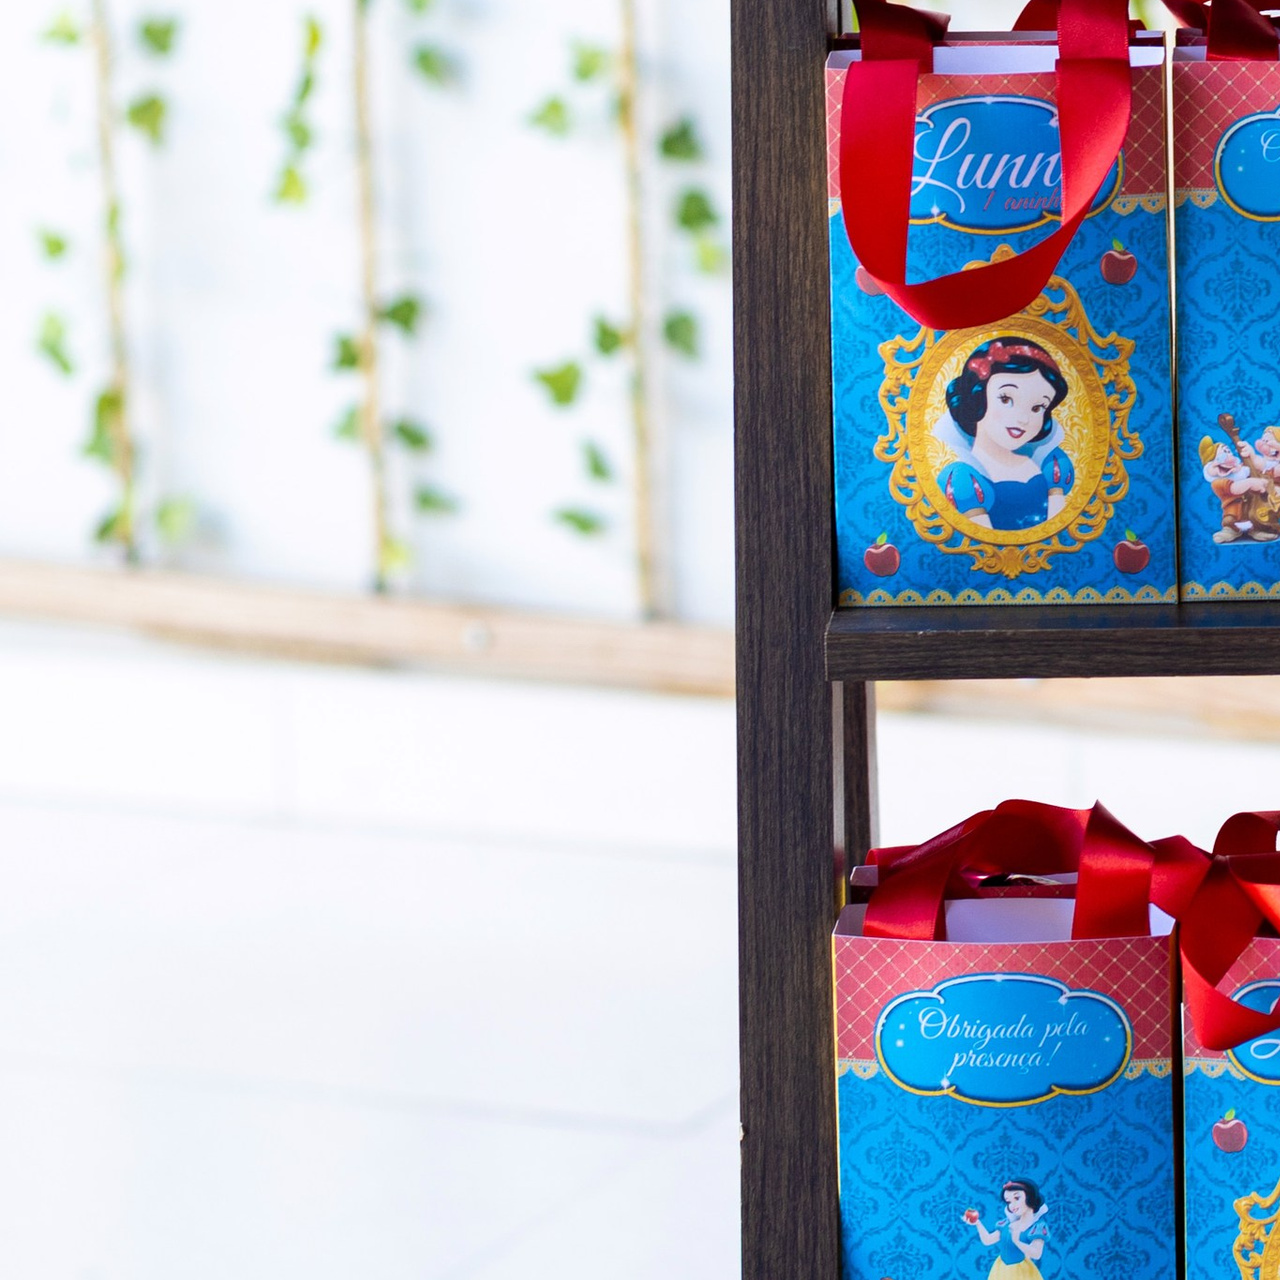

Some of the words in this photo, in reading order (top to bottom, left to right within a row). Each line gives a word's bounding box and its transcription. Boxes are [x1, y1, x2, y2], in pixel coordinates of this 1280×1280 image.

[911, 117, 1063, 213] Lunn
[1004, 188, 1065, 210] aninh
[918, 1006, 1035, 1050] Obrigada
[1038, 1012, 1090, 1048] pela
[946, 1042, 1062, 1077] presença!
